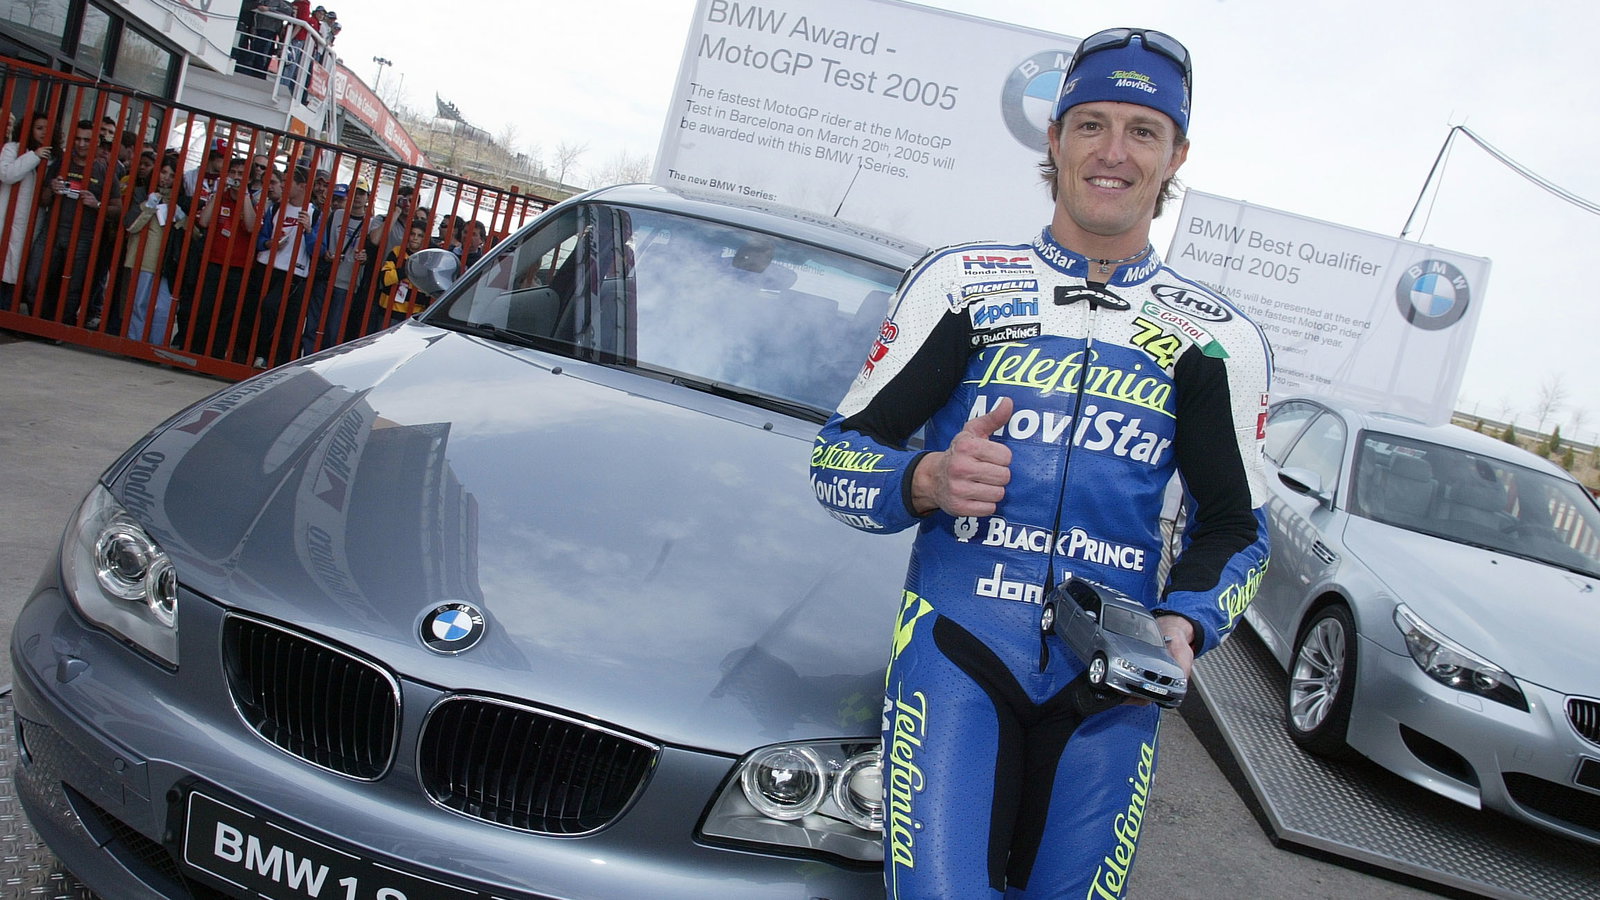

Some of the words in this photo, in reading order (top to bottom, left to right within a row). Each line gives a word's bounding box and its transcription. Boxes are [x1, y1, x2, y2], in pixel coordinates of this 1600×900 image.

[708, 0, 787, 34] BMW
[789, 16, 880, 56] Award
[698, 34, 813, 79] MotoGP
[820, 58, 876, 94] Test
[883, 74, 960, 111] 2005
[1115, 78, 1158, 95] MoviStar
[690, 82, 715, 101] The
[718, 88, 762, 110] fastest
[763, 98, 819, 121] MotoGP
[821, 111, 853, 129] rider
[854, 121, 867, 133] at
[870, 123, 892, 139] the
[895, 127, 952, 150] MotoGP
[680, 116, 697, 131] be
[699, 119, 755, 144] awarded
[757, 136, 785, 152] with
[788, 139, 812, 157] this
[815, 146, 853, 166] BMW
[686, 99, 712, 117] Test
[714, 104, 727, 119] in
[729, 109, 794, 135] Barcelona
[797, 126, 814, 139] on
[817, 128, 859, 149] March
[895, 146, 930, 165] 2005
[933, 154, 955, 170] will
[668, 169, 686, 181] The
[687, 174, 708, 186] new
[709, 178, 737, 192] BMW
[962, 255, 1033, 270] HRC
[1180, 242, 1244, 271] Award
[1248, 260, 1301, 286] 2005
[1188, 216, 1246, 244] BMW
[1247, 230, 1294, 257] Best
[1298, 243, 1382, 278] Qualifier
[965, 280, 1035, 296] MICHELIN
[1408, 260, 1468, 291] BMW
[987, 297, 1039, 324] polini
[1158, 289, 1223, 317] Arai
[1226, 285, 1242, 299] M5
[1244, 290, 1259, 303] will
[1260, 294, 1273, 306] be
[1274, 300, 1322, 318] presented
[1323, 311, 1333, 321] at
[1335, 313, 1351, 325] the
[1352, 318, 1371, 330] end
[1160, 310, 1206, 340] Castrol
[1248, 304, 1263, 317] the
[1264, 309, 1296, 325] fastest
[1299, 316, 1338, 334] MotoGP
[1339, 327, 1362, 340] rider
[1281, 327, 1303, 336] over
[1304, 332, 1320, 342] the
[1321, 336, 1343, 349] year.
[1129, 316, 1182, 370] 74
[437, 604, 483, 625] BMW
[214, 821, 330, 898] BMW
